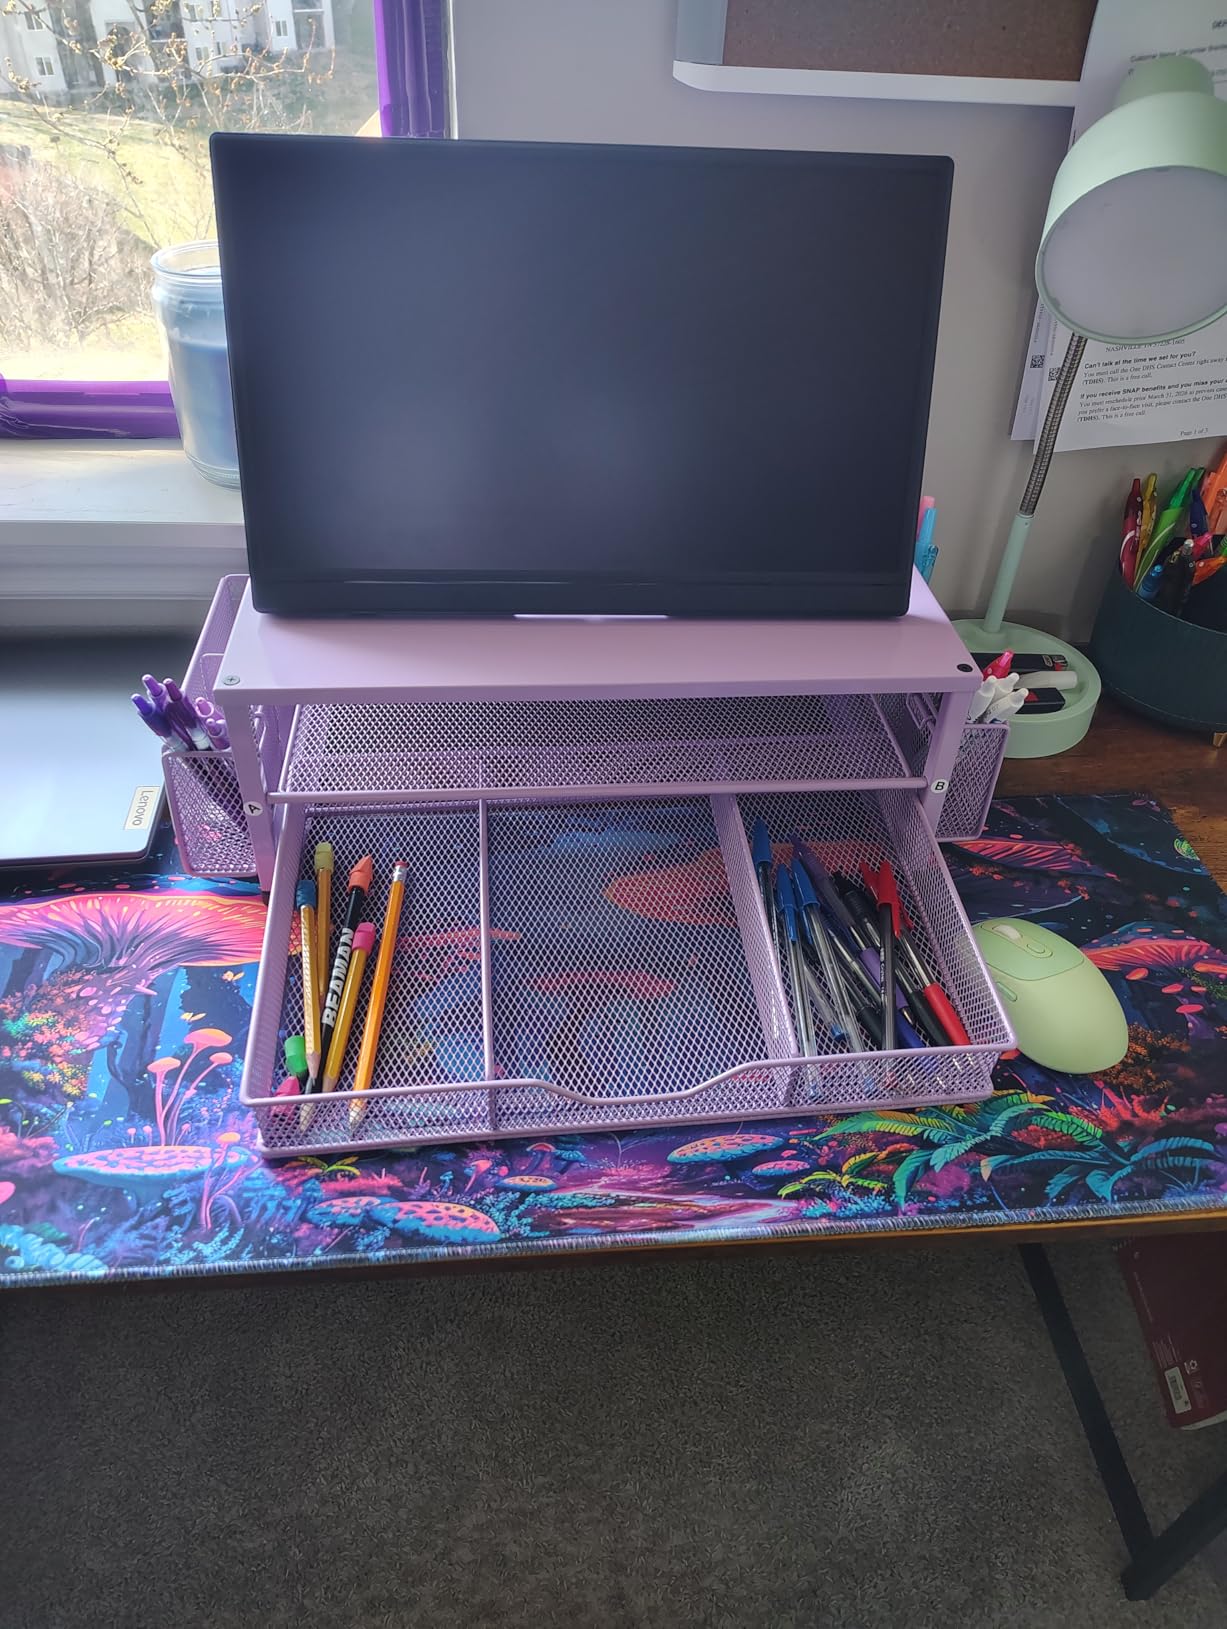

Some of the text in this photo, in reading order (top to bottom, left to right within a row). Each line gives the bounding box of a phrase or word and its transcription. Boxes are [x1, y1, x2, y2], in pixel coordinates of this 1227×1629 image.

[1180, 351, 1196, 359] you?
[934, 781, 946, 791] B
[131, 790, 154, 826] Lenovo
[247, 803, 262, 815] A
[321, 927, 354, 1028] BEAMAN
